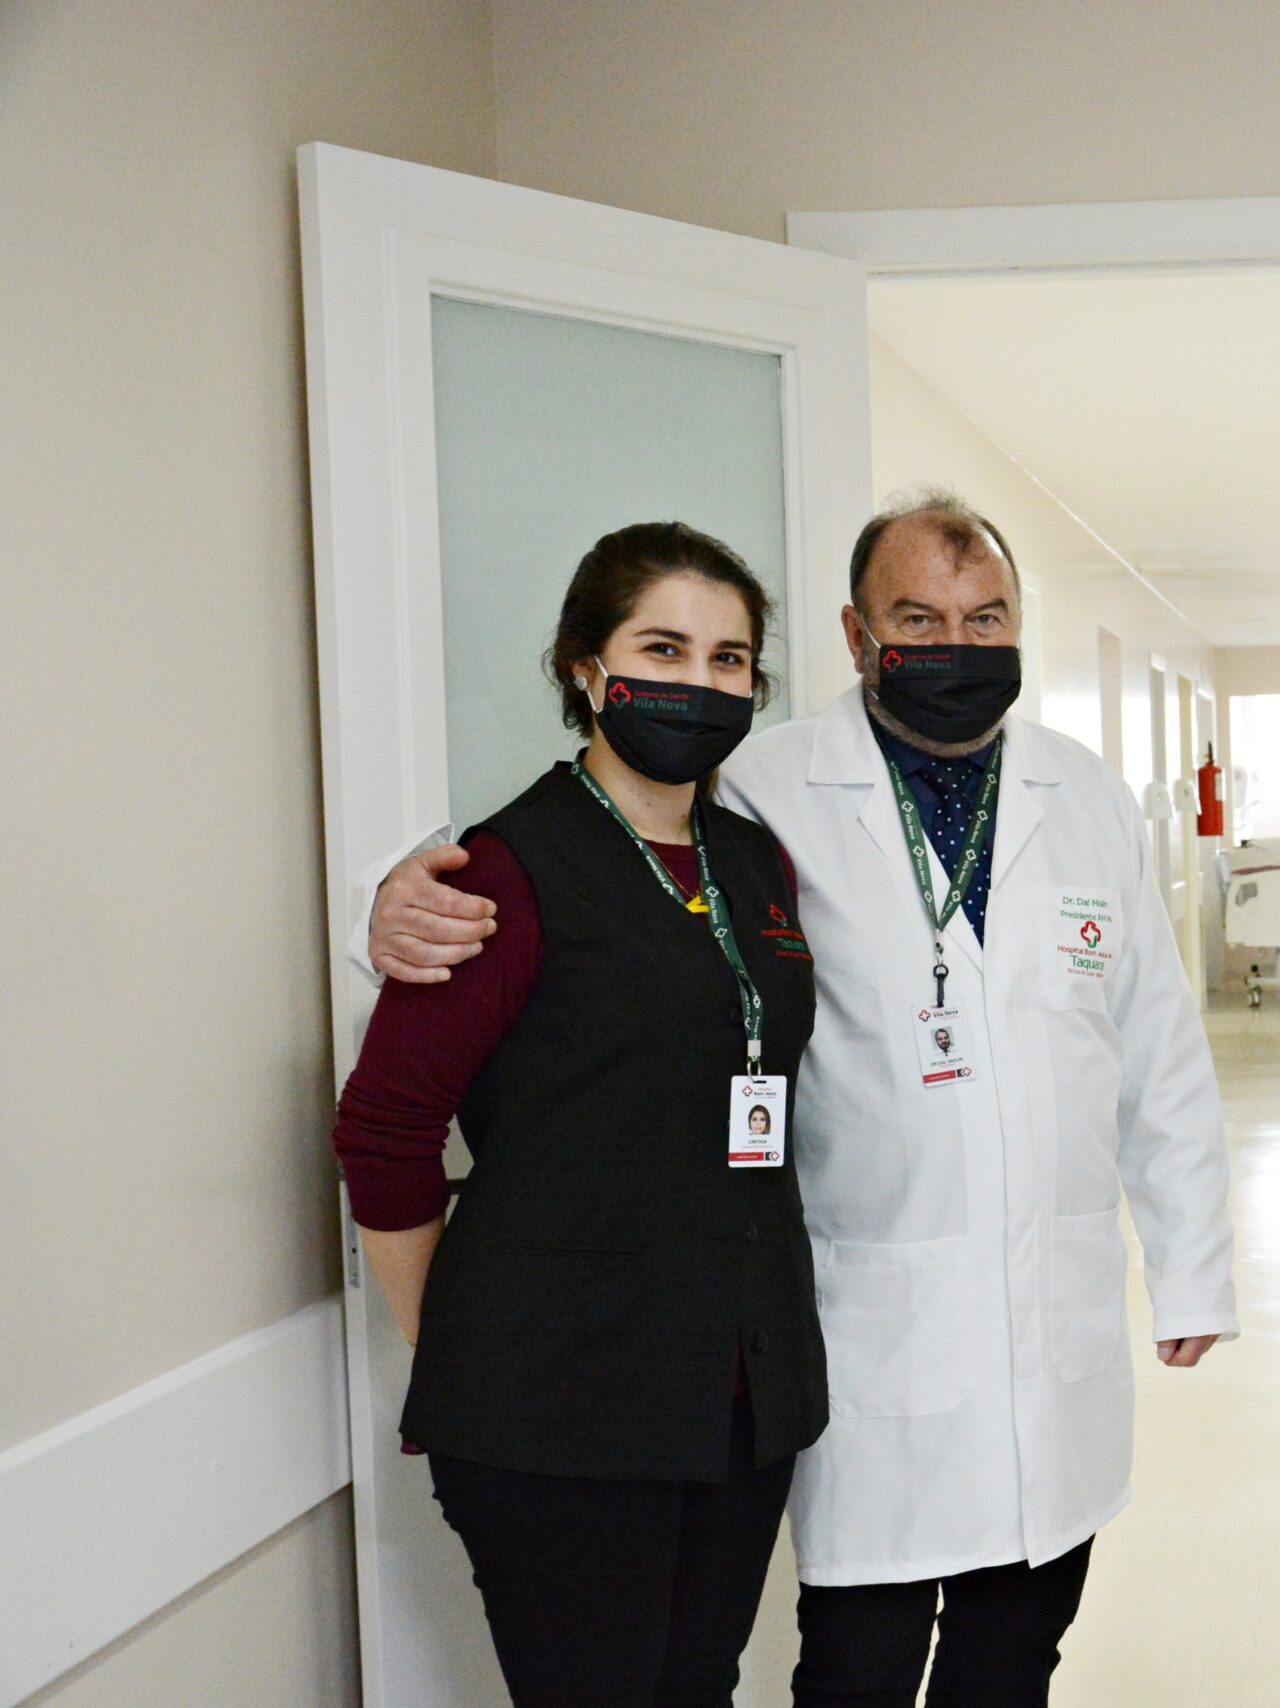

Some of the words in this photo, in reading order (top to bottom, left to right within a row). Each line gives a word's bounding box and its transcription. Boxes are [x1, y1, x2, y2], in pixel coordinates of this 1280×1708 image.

[633, 696, 655, 709] Vila
[657, 699, 689, 711] Nova
[1062, 896, 1075, 905] Dr.
[1076, 897, 1090, 907] Dal
